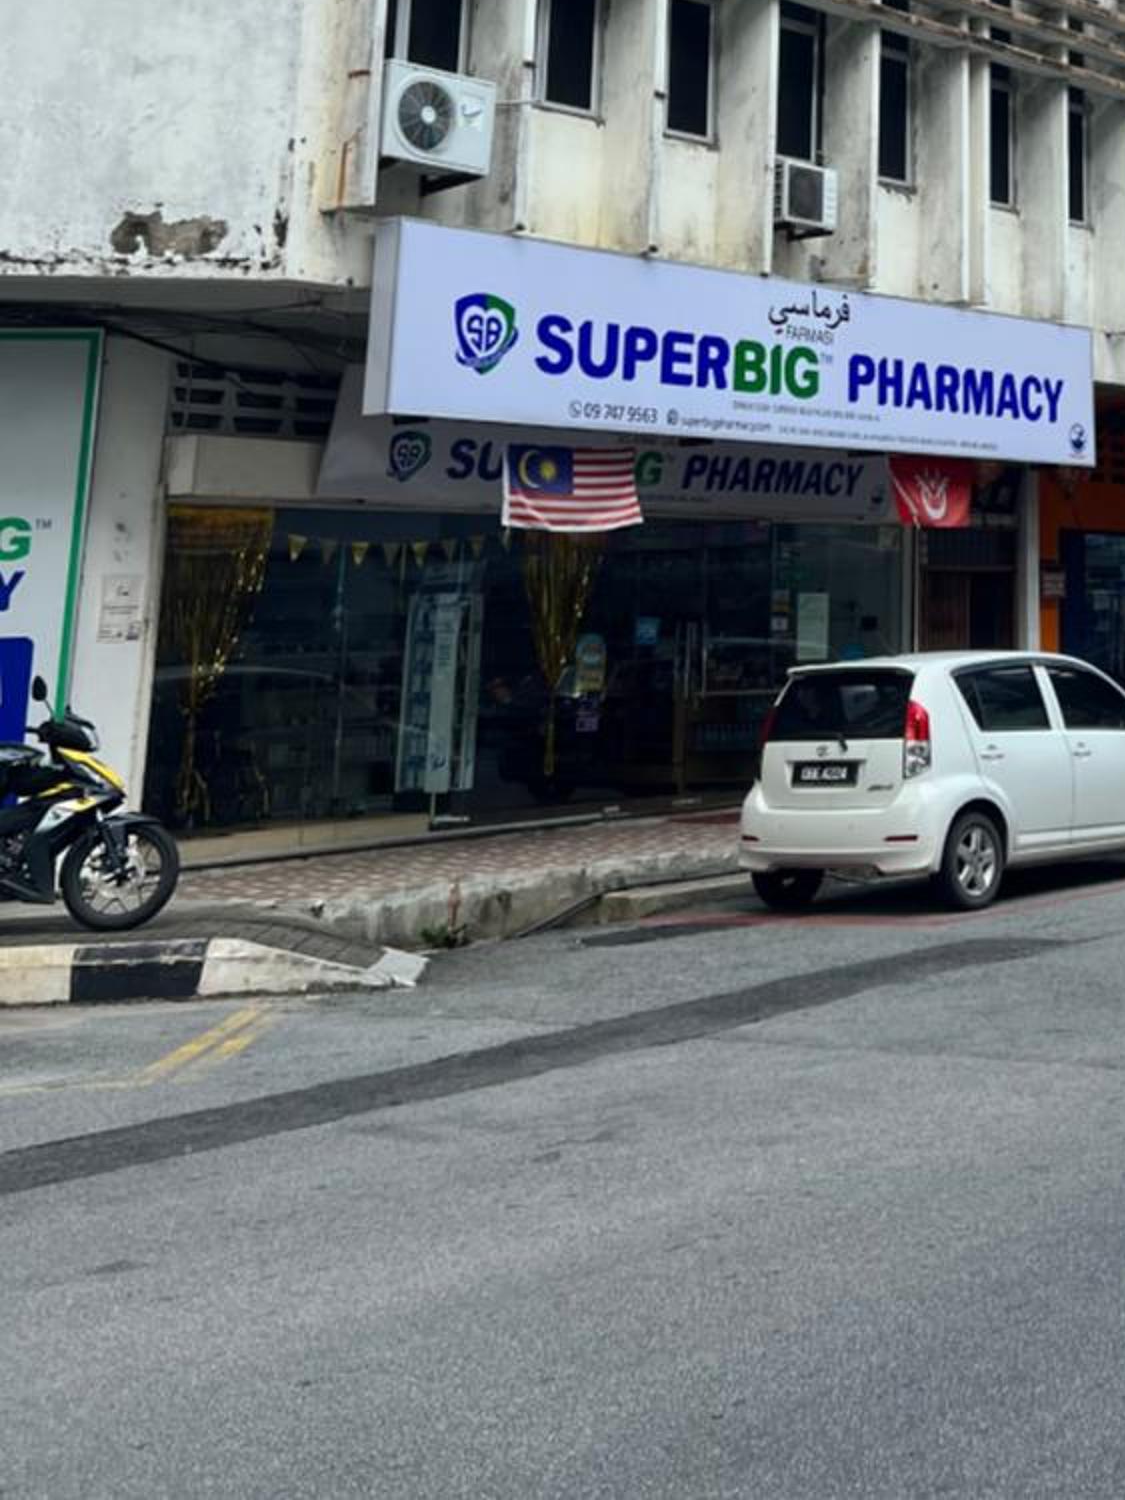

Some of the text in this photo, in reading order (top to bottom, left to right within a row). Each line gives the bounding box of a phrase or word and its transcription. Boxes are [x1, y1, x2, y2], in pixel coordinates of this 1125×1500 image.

[768, 290, 850, 335] فرماسي
[786, 325, 834, 345] FARMASI
[534, 314, 820, 399] SUPERBIG
[847, 353, 1064, 423] PHARMACY
[681, 453, 864, 498] PHARMACY
